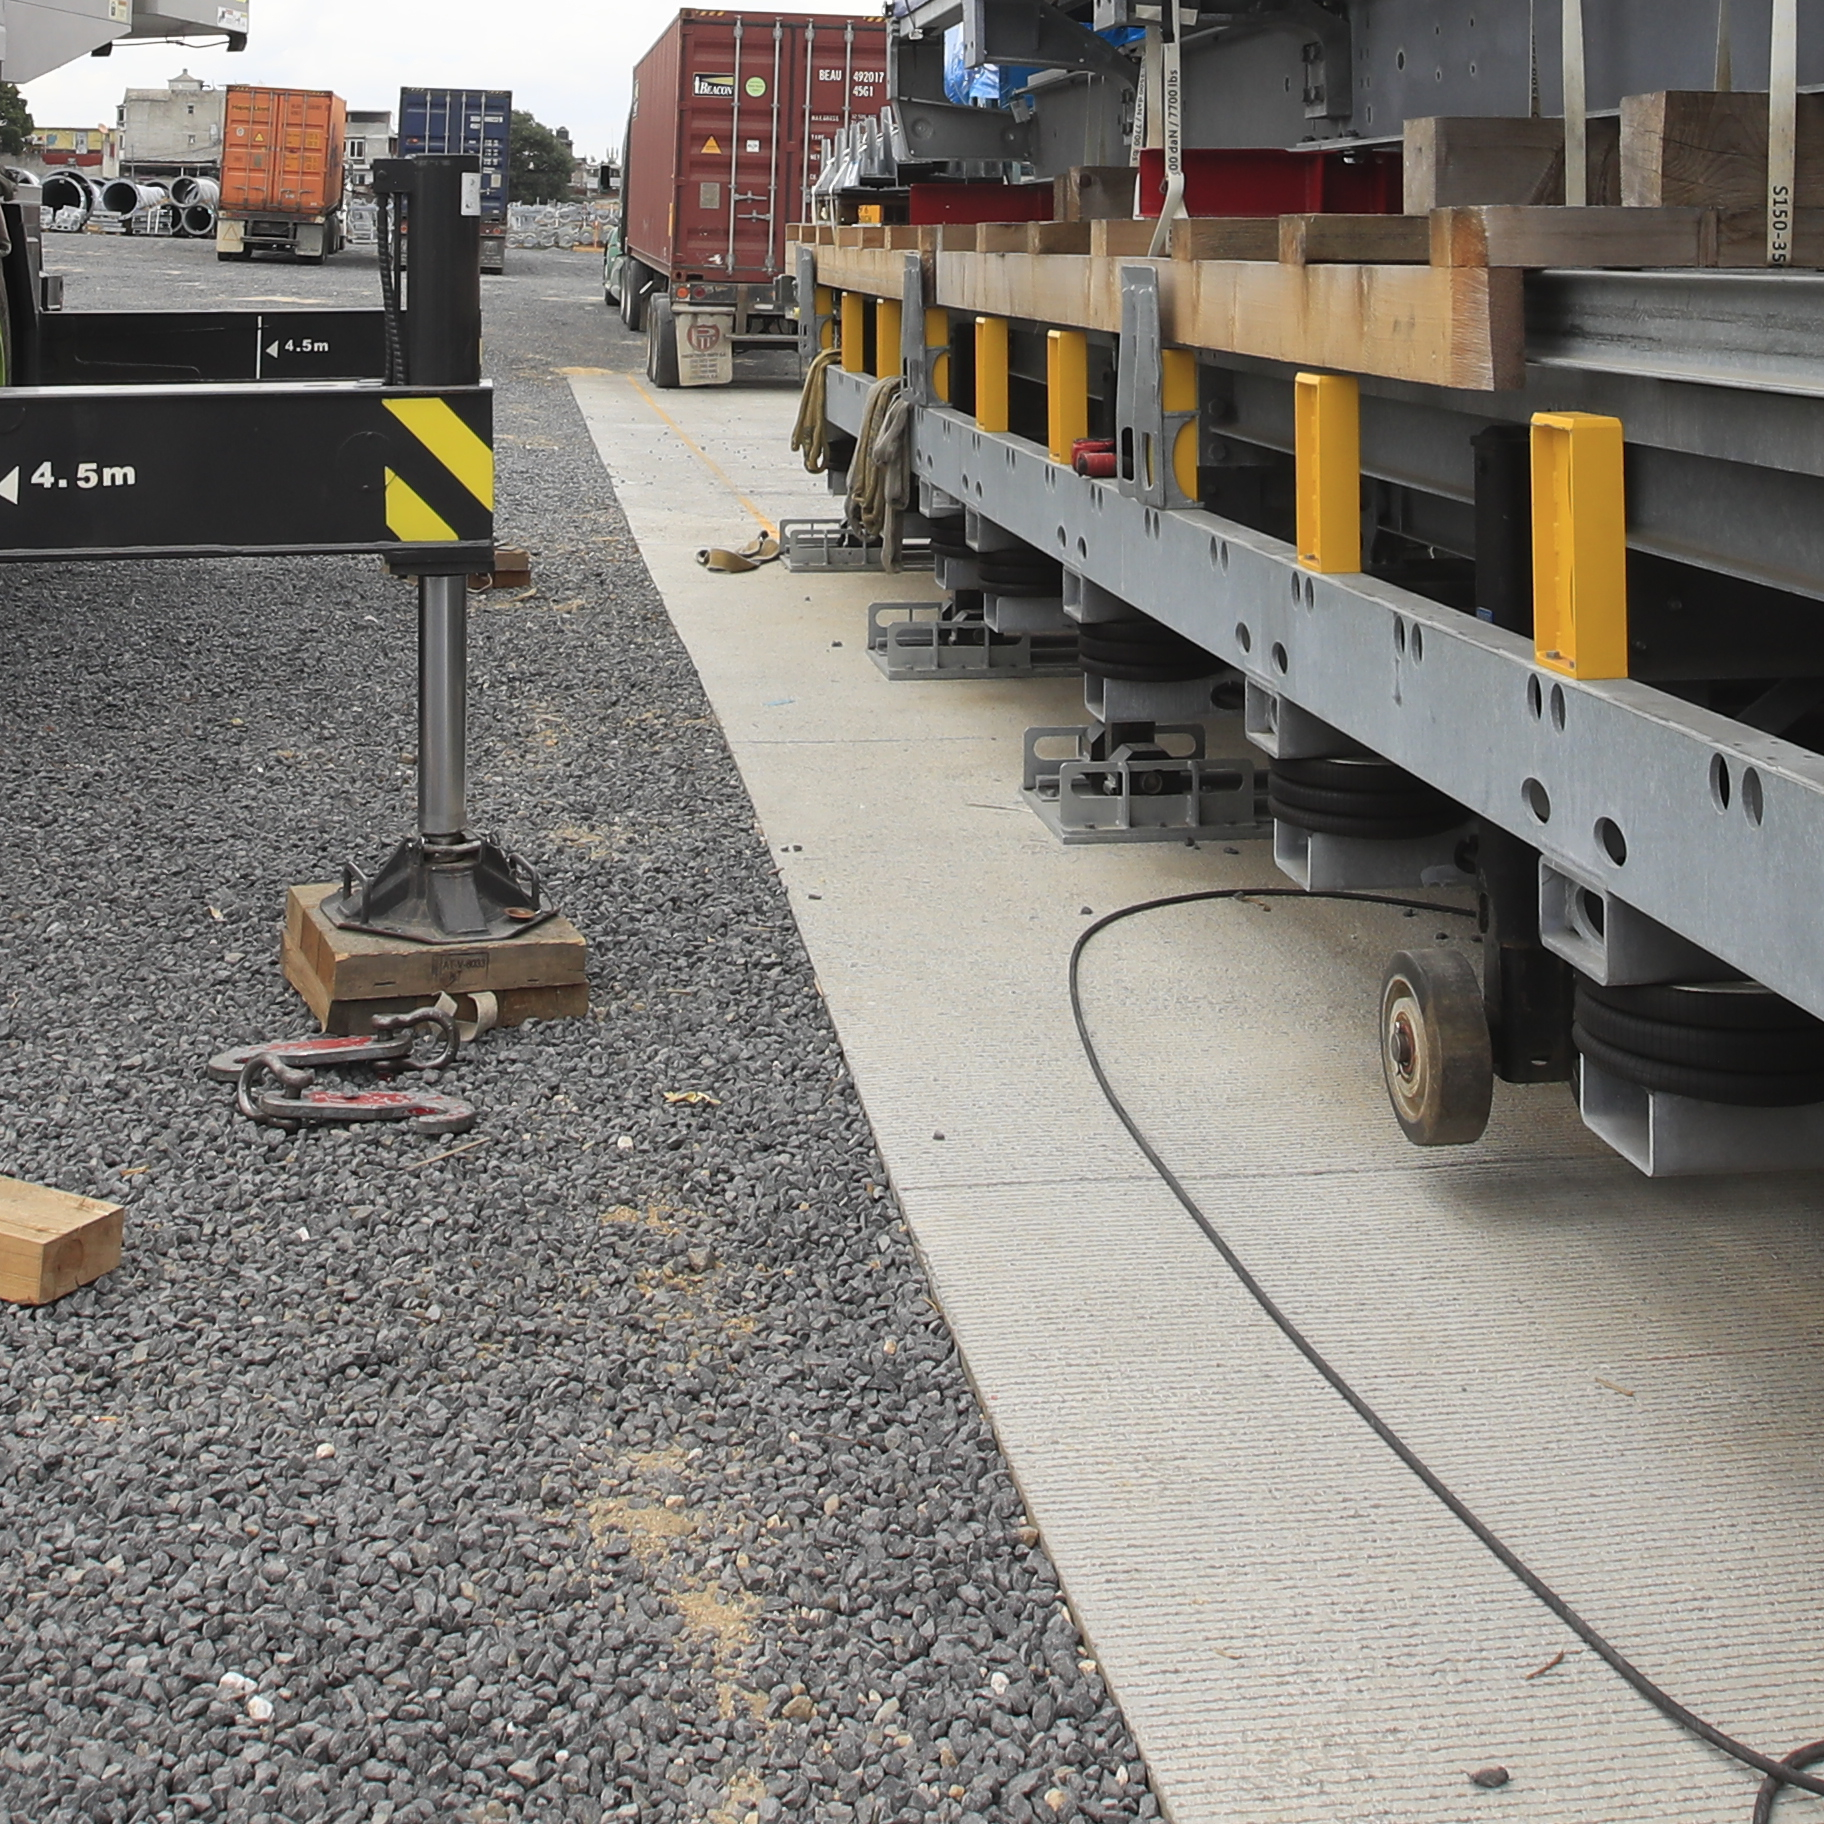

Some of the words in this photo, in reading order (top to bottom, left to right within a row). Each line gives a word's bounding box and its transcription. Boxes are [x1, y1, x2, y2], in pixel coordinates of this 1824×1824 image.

[819, 69, 843, 81] BEAU
[852, 71, 885, 84] 492017
[1168, 69, 1178, 87] lbs
[852, 85, 874, 97] 45G1
[1168, 89, 1179, 118] 7700
[1168, 129, 1179, 154] daN
[284, 338, 330, 354] 4.5m
[30, 459, 137, 491] 4.5m
